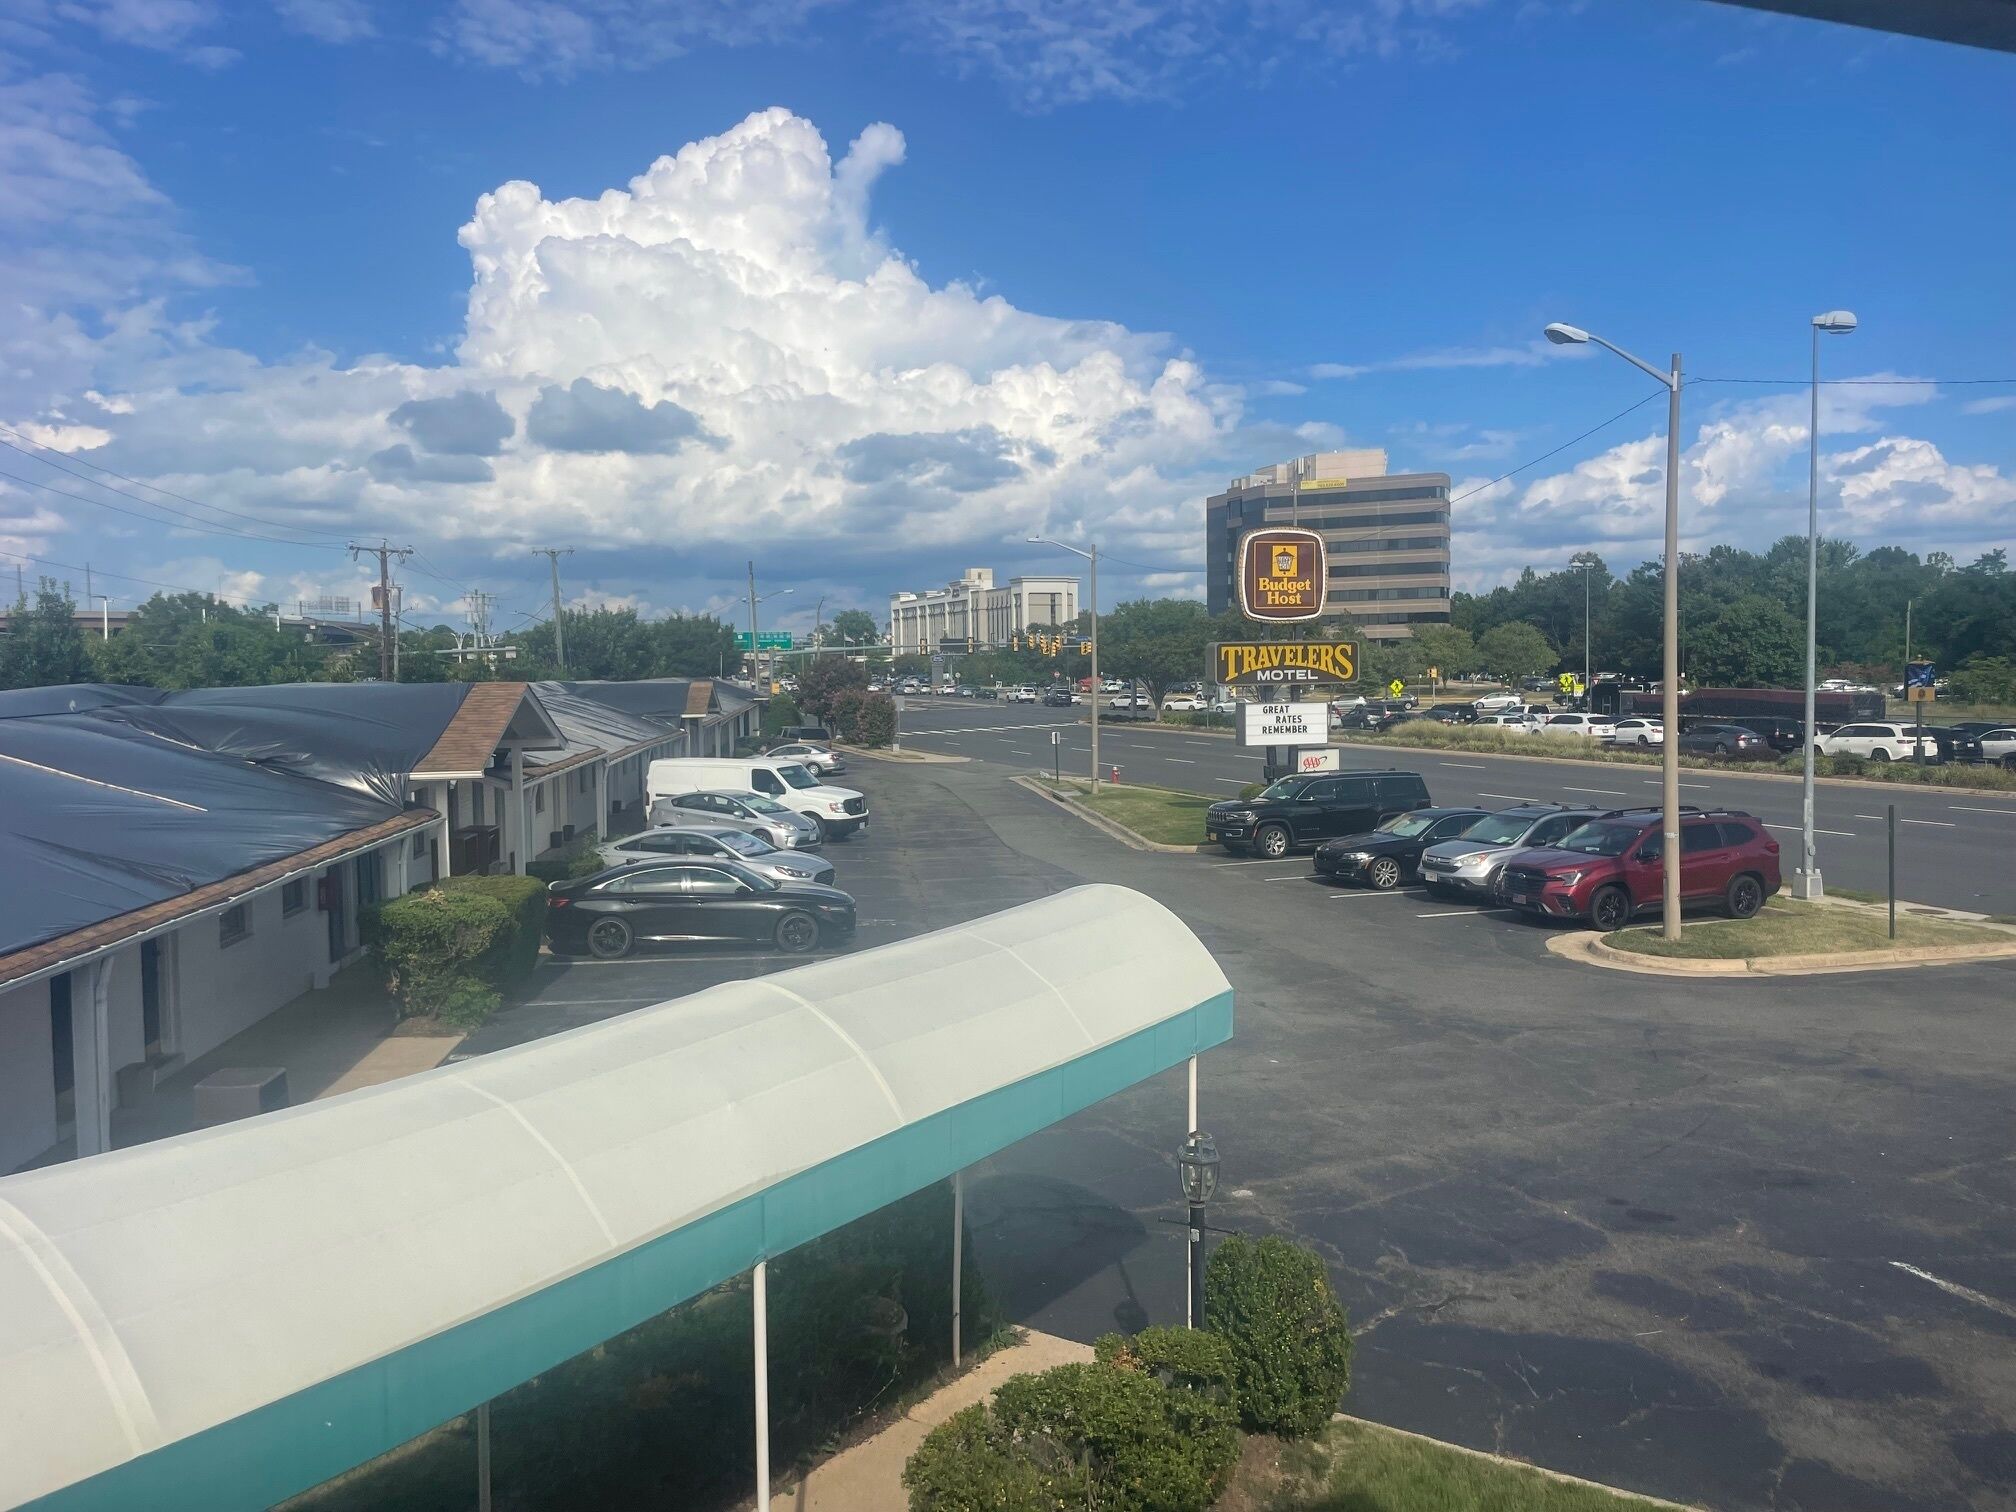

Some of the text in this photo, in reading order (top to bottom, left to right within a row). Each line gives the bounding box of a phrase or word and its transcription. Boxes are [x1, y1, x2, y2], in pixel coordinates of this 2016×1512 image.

[1258, 577, 1311, 593] Budget
[1267, 591, 1302, 605] Host
[1221, 644, 1354, 682] TRAVELERS
[1257, 669, 1318, 681] MOTEL
[1262, 705, 1290, 714] GREAT
[1275, 715, 1303, 724] RATES
[1262, 725, 1308, 734] REMEMBER
[1303, 757, 1320, 768] AAA
